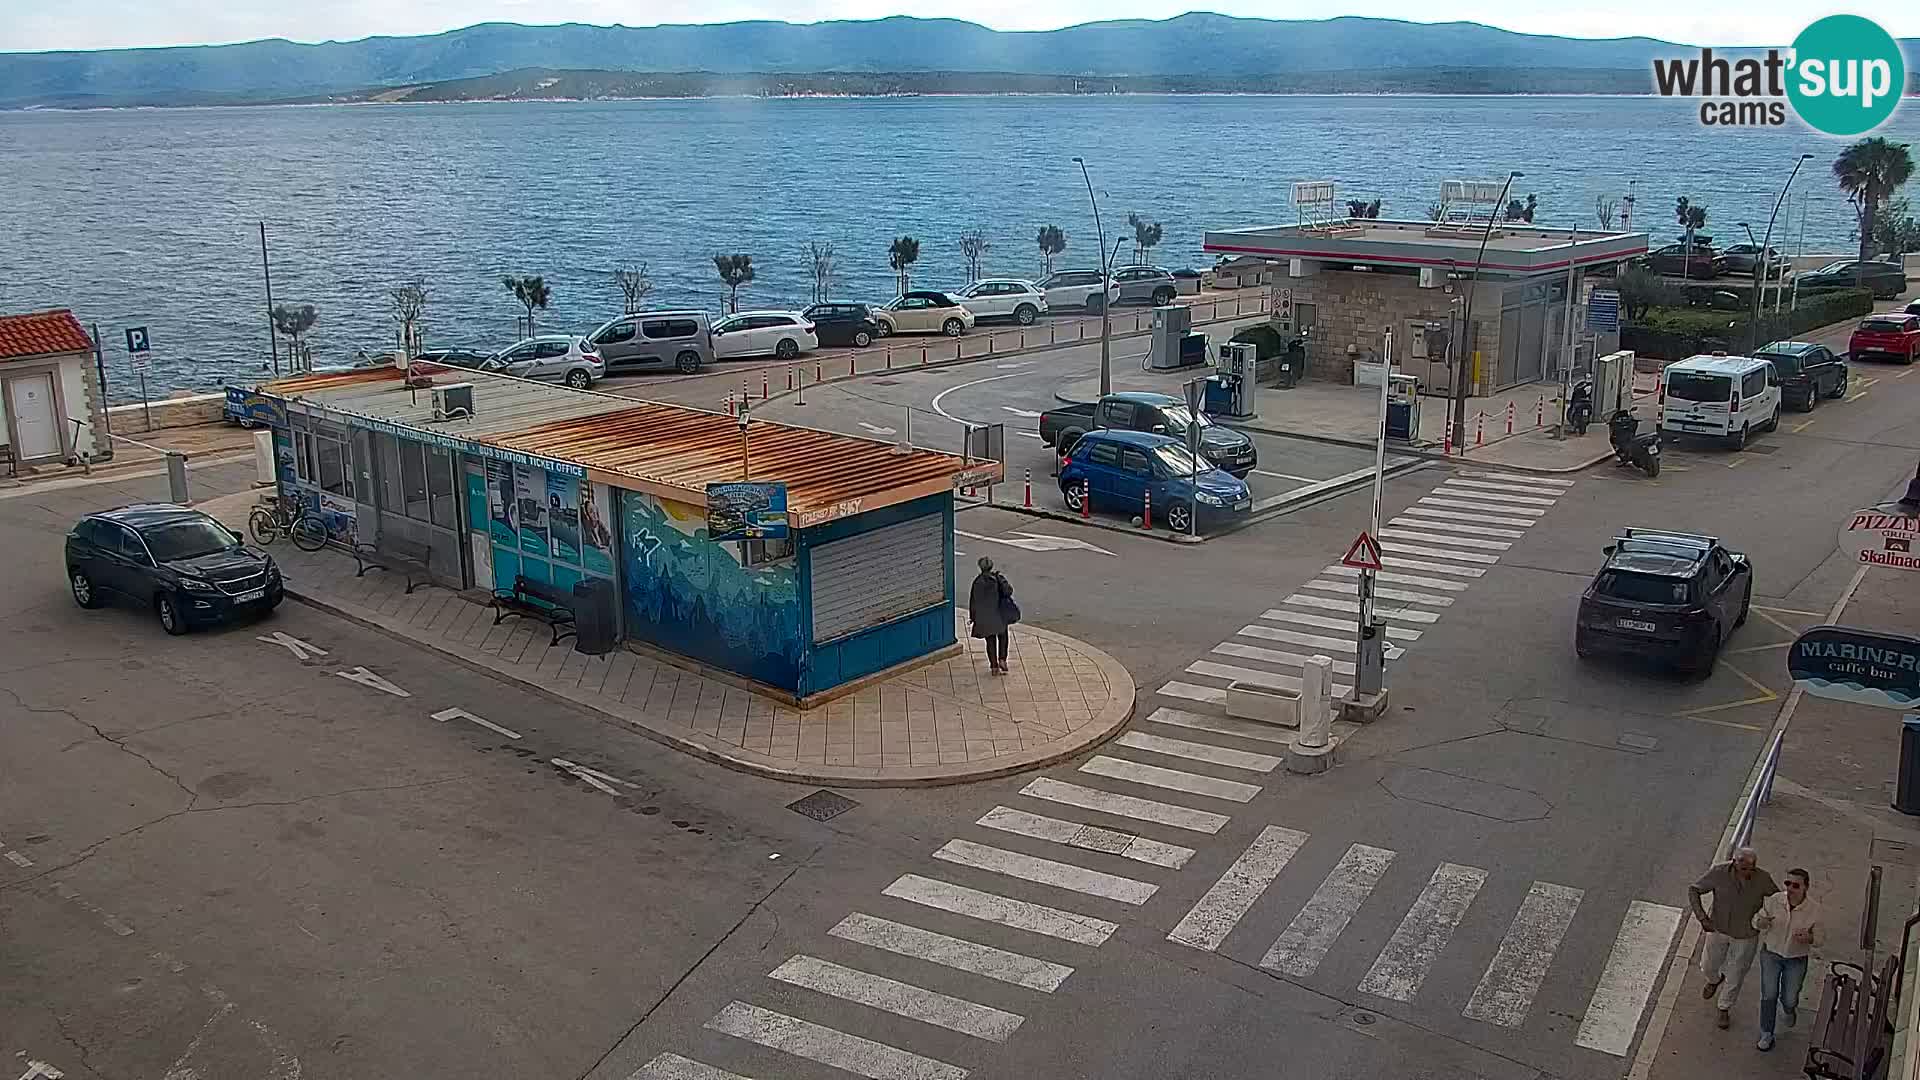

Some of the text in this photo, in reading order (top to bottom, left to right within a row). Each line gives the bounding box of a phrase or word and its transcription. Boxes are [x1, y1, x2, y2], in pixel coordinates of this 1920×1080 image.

[131, 331, 144, 349] P
[478, 446, 493, 457] BUS
[495, 450, 527, 464] STATION
[530, 456, 554, 471] TICKET
[556, 462, 582, 477] OFFICE
[1848, 515, 1920, 533] PIZZE
[1882, 530, 1916, 540] GRILL
[1829, 662, 1897, 680] caffe bar
